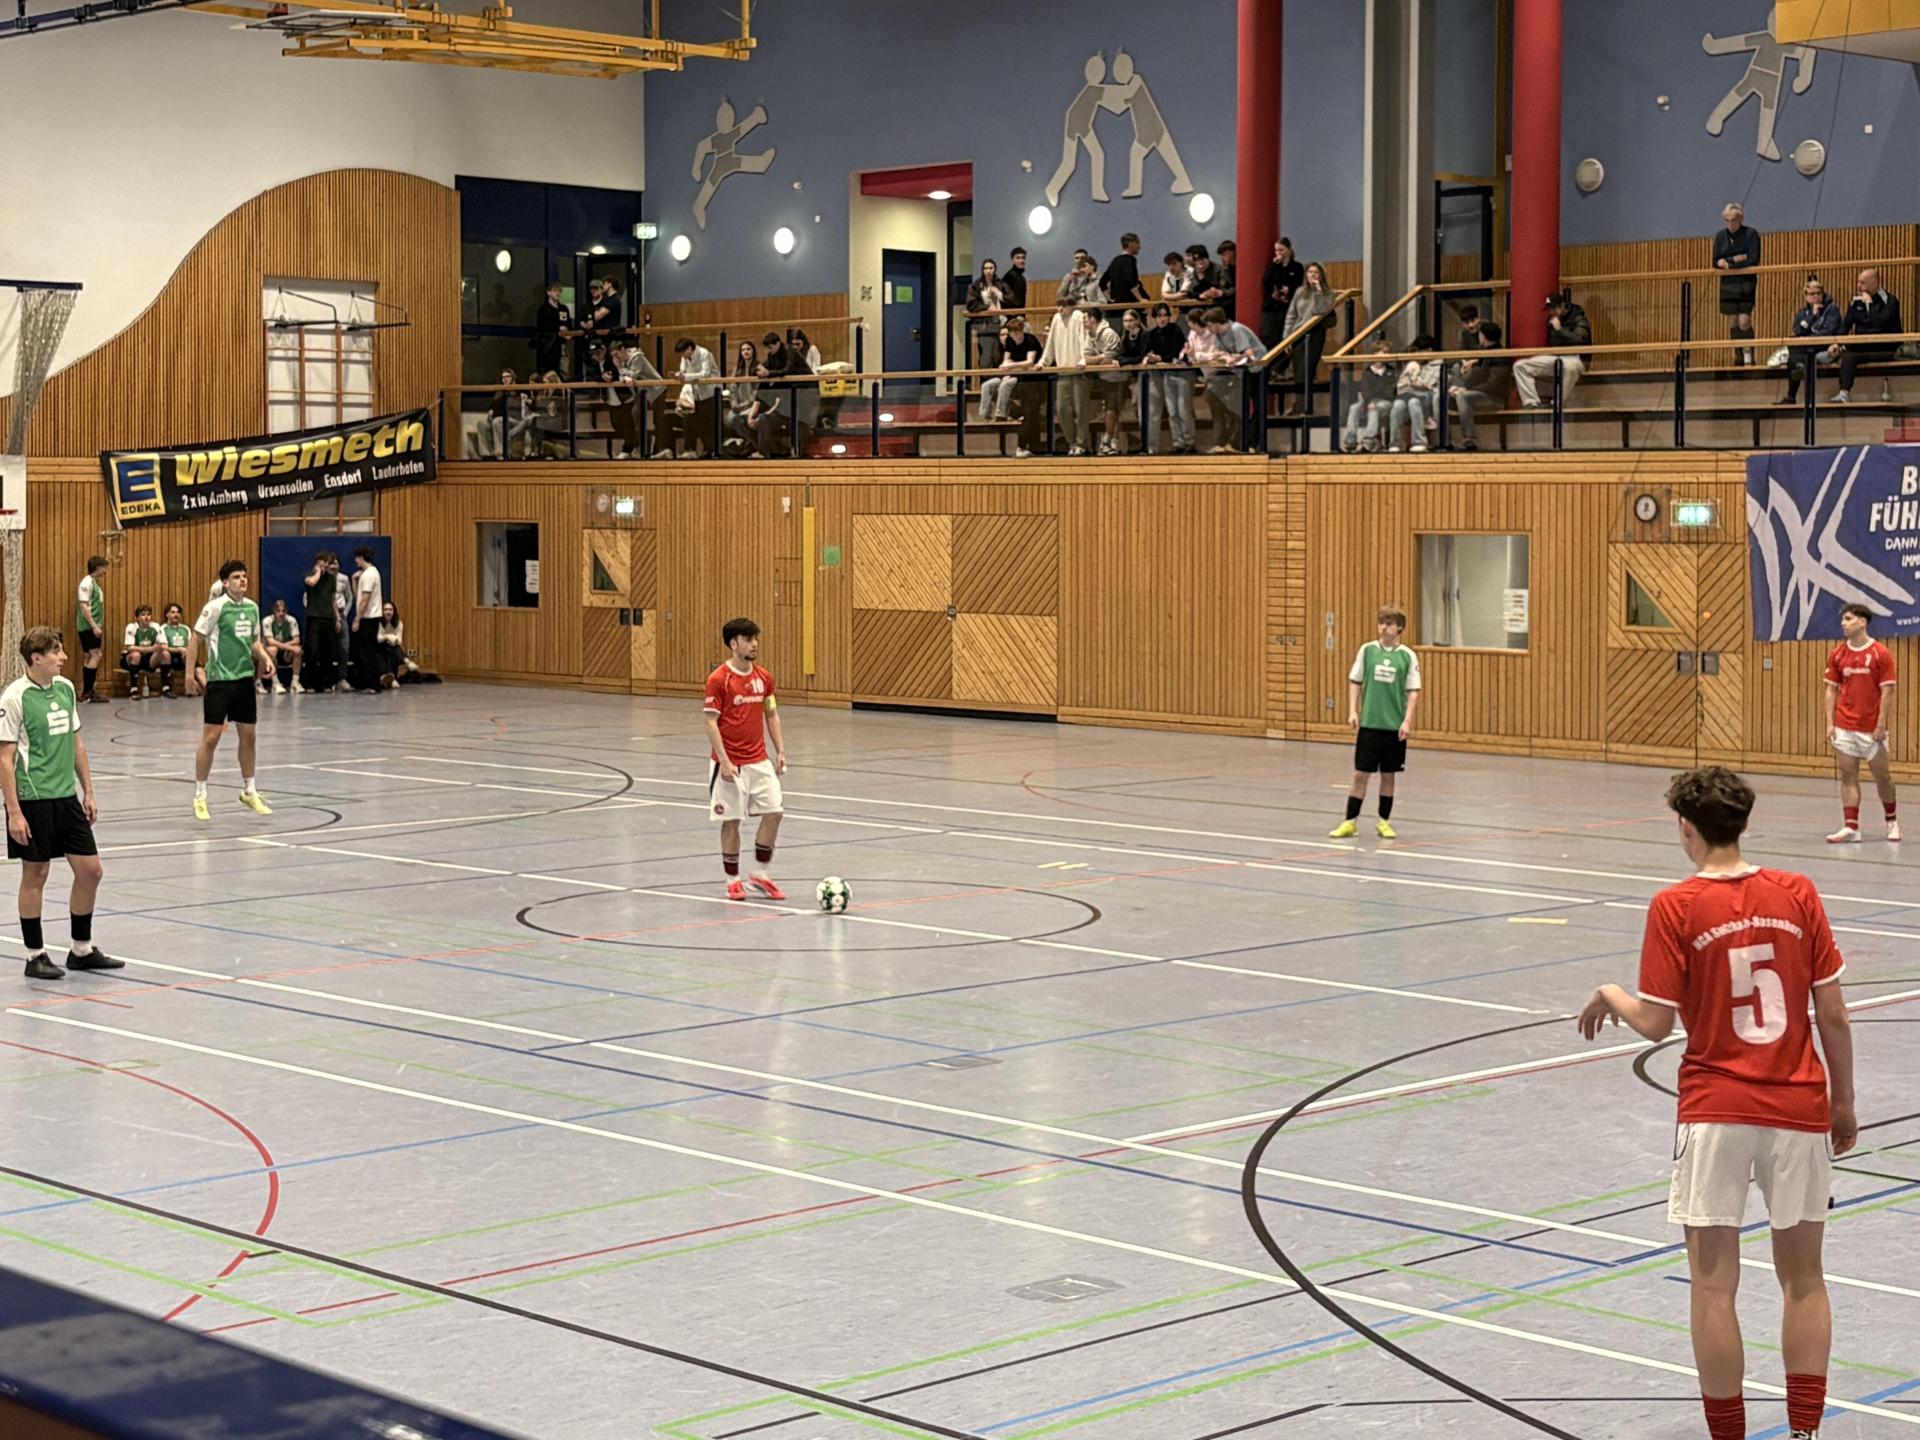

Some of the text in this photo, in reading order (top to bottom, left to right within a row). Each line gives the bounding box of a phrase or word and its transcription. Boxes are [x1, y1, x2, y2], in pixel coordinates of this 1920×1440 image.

[175, 420, 424, 486] Wiesmeth
[209, 489, 248, 505] Amberg
[258, 479, 314, 499] Ursensollen
[324, 468, 362, 489] Ensdorf
[372, 460, 425, 481] Lauterhofen
[120, 502, 161, 516] EDEKA
[1885, 536, 1918, 552] DANN
[1728, 943, 1787, 1044] 5
